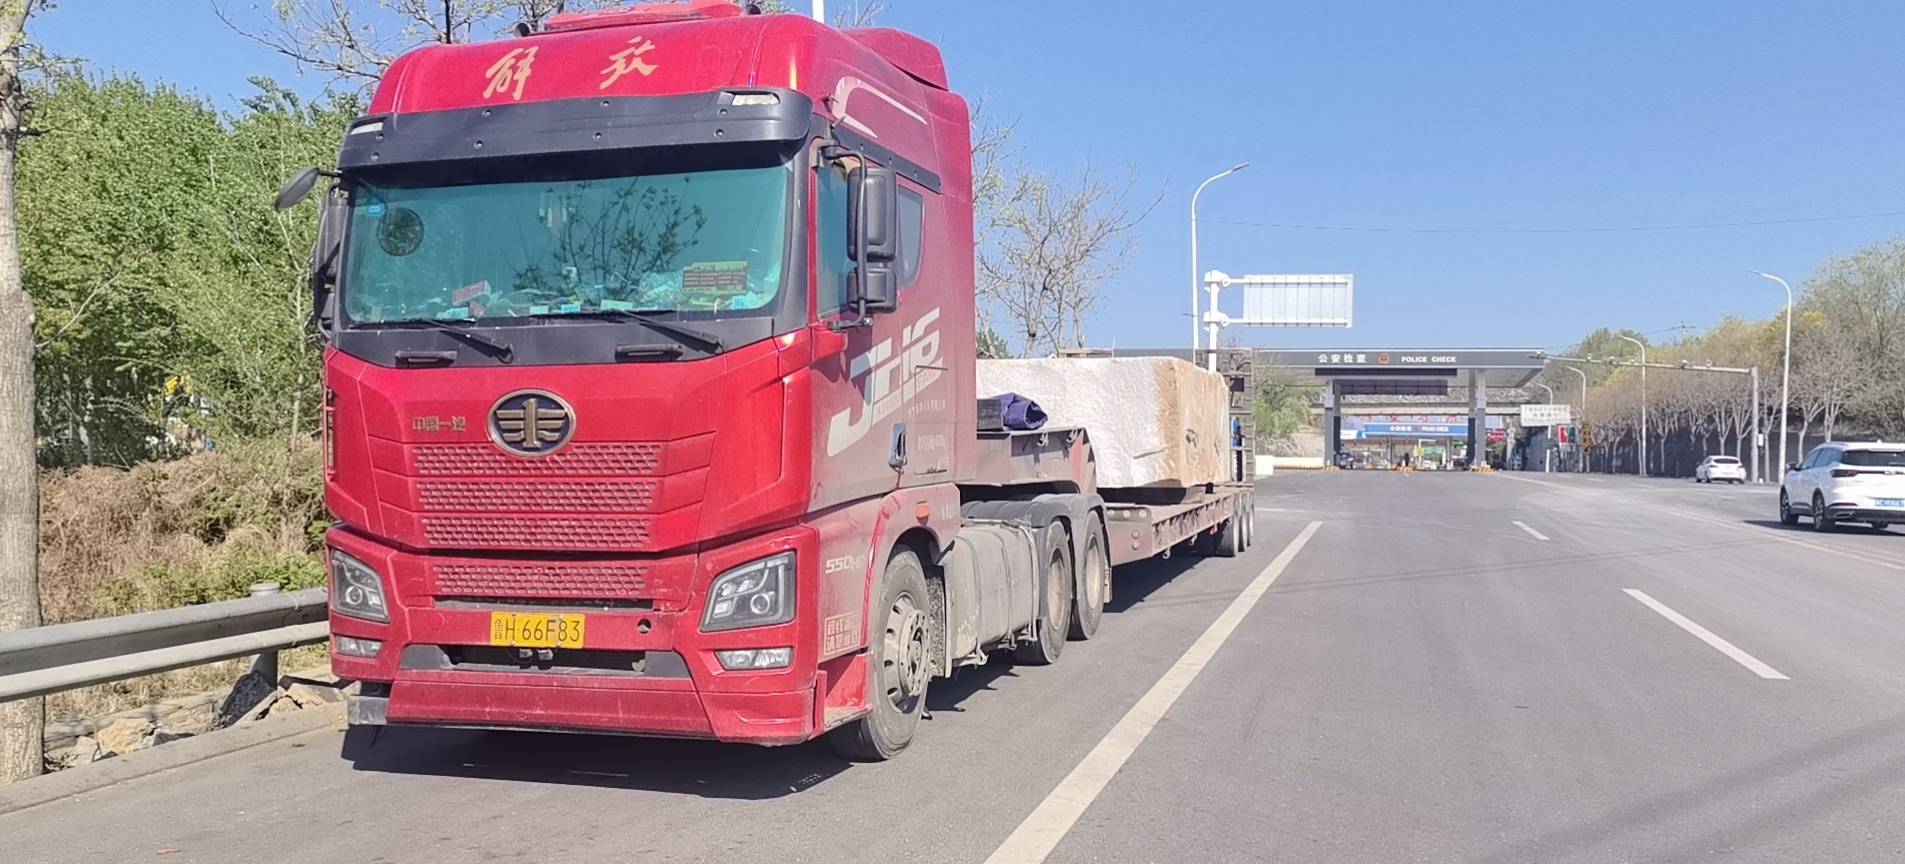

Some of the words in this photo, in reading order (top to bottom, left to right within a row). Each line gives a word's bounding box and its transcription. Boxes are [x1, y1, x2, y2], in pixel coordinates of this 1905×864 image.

[483, 36, 659, 101] 解放
[1318, 354, 1366, 363] 公安检查
[1401, 355, 1427, 363] POLICE
[1431, 355, 1457, 363] CHECK
